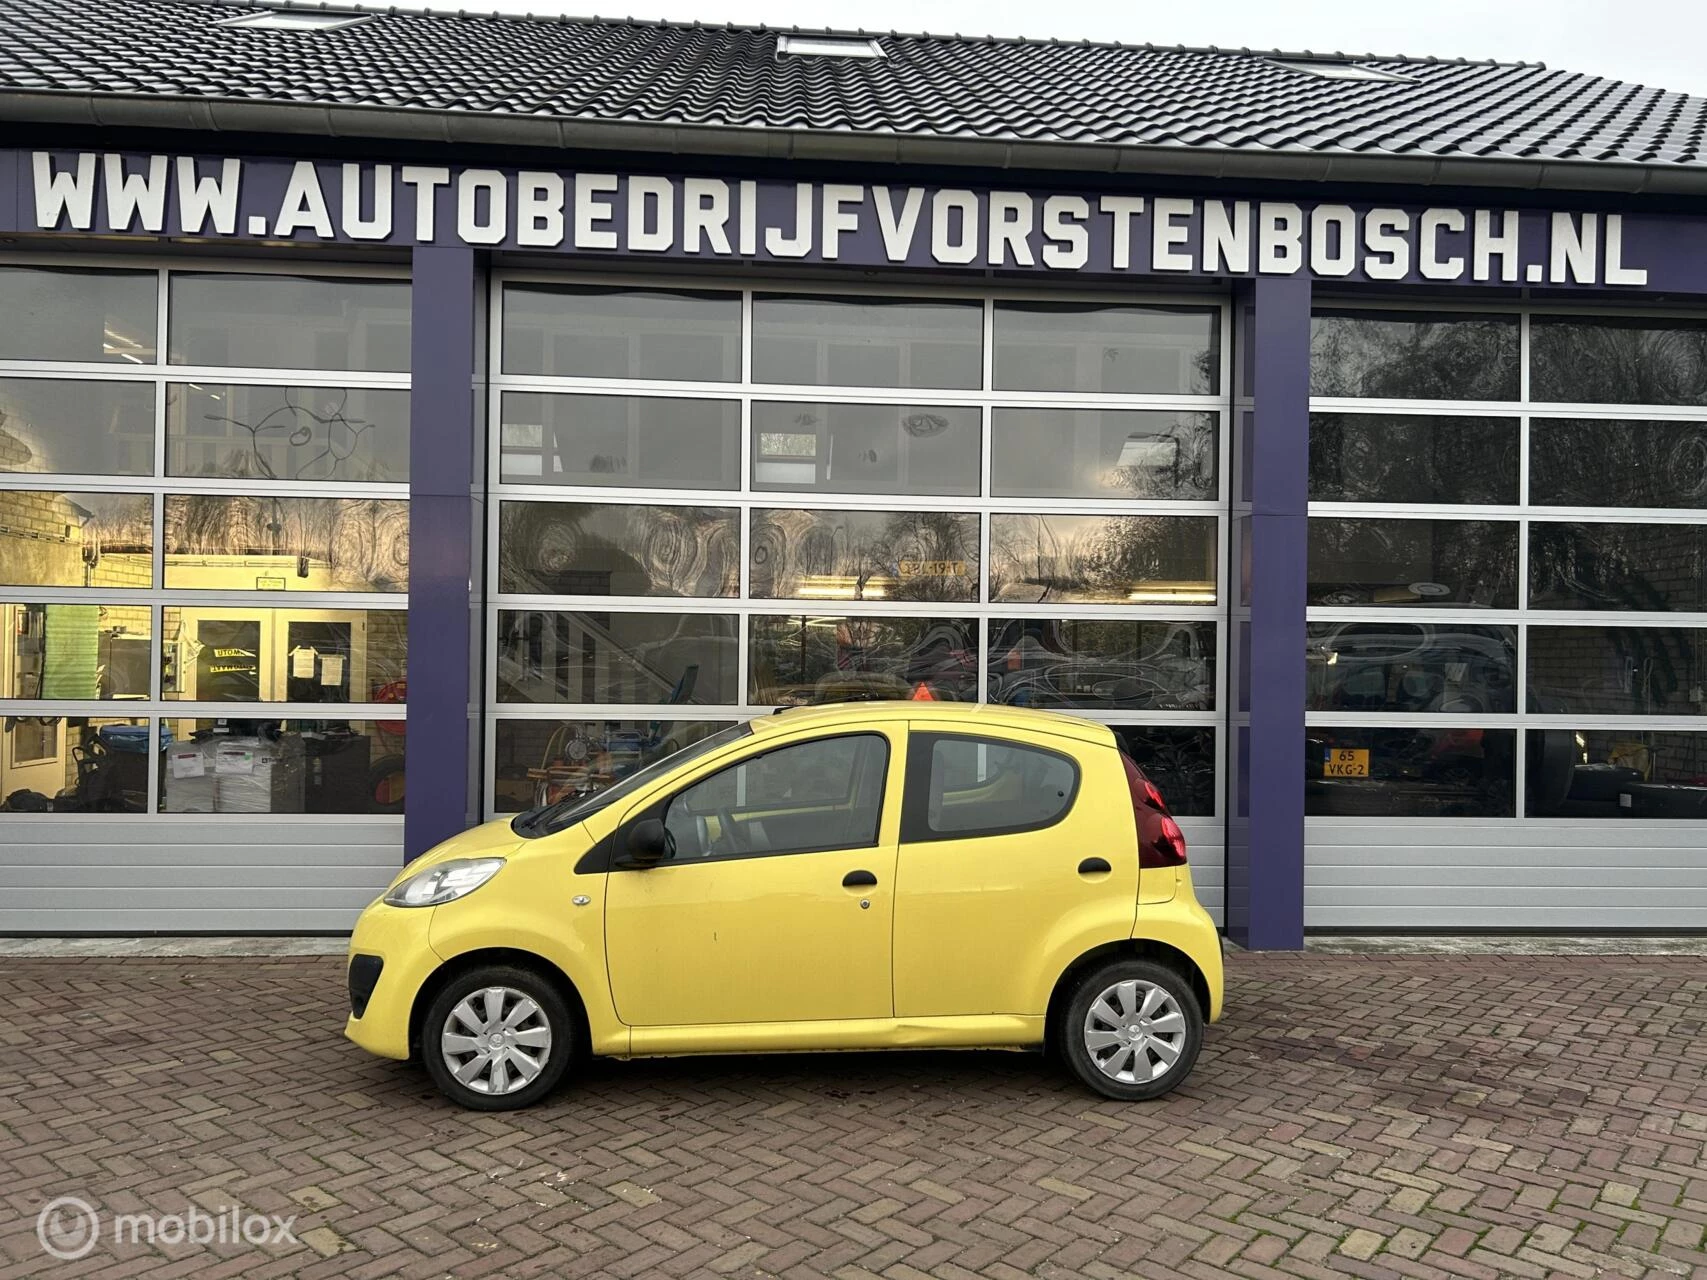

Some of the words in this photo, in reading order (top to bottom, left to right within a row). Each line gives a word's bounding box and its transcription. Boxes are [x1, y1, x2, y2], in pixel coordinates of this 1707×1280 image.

[32, 151, 1648, 287] WWW.AUTOBEDRIJFVORSTENBOSCH.NL
[1339, 750, 1354, 761] 65
[1329, 764, 1364, 775] VKG-2
